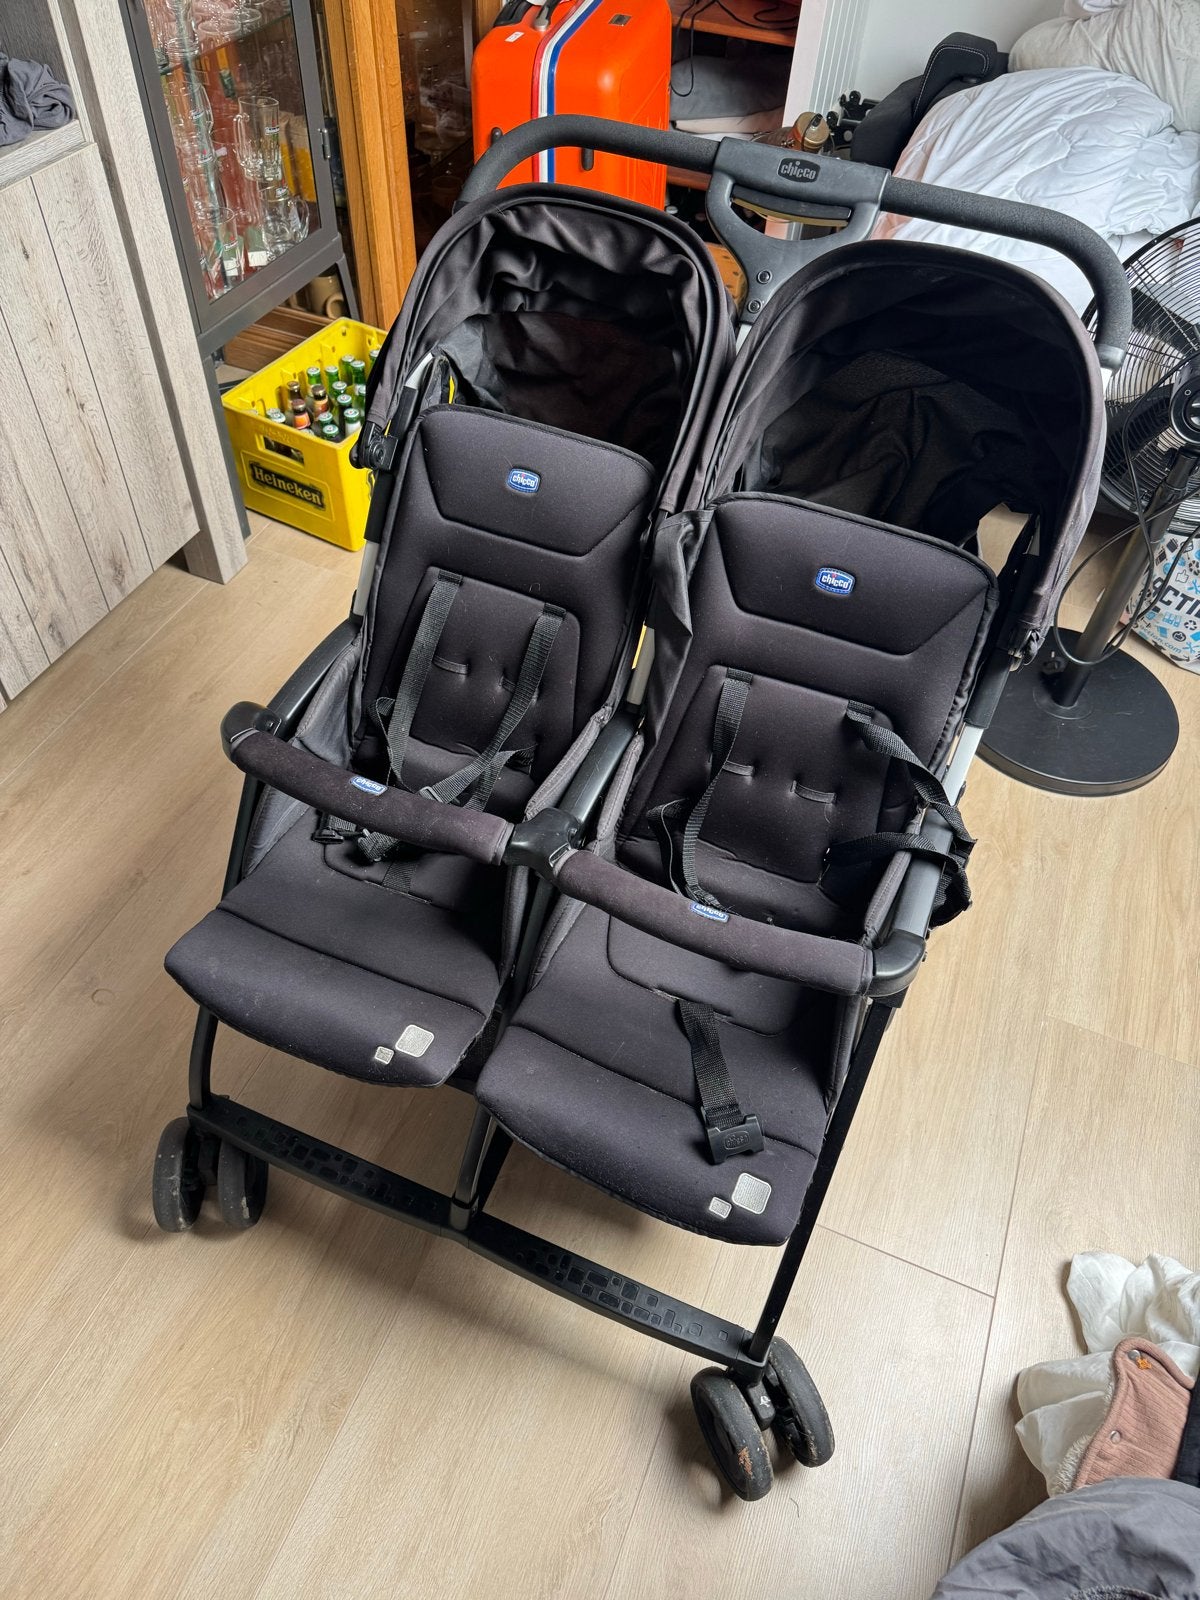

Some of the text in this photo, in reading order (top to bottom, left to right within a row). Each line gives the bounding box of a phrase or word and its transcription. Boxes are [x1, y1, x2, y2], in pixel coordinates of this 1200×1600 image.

[780, 160, 817, 180] chicco
[253, 464, 322, 506] Heineken
[821, 573, 849, 589] chicco
